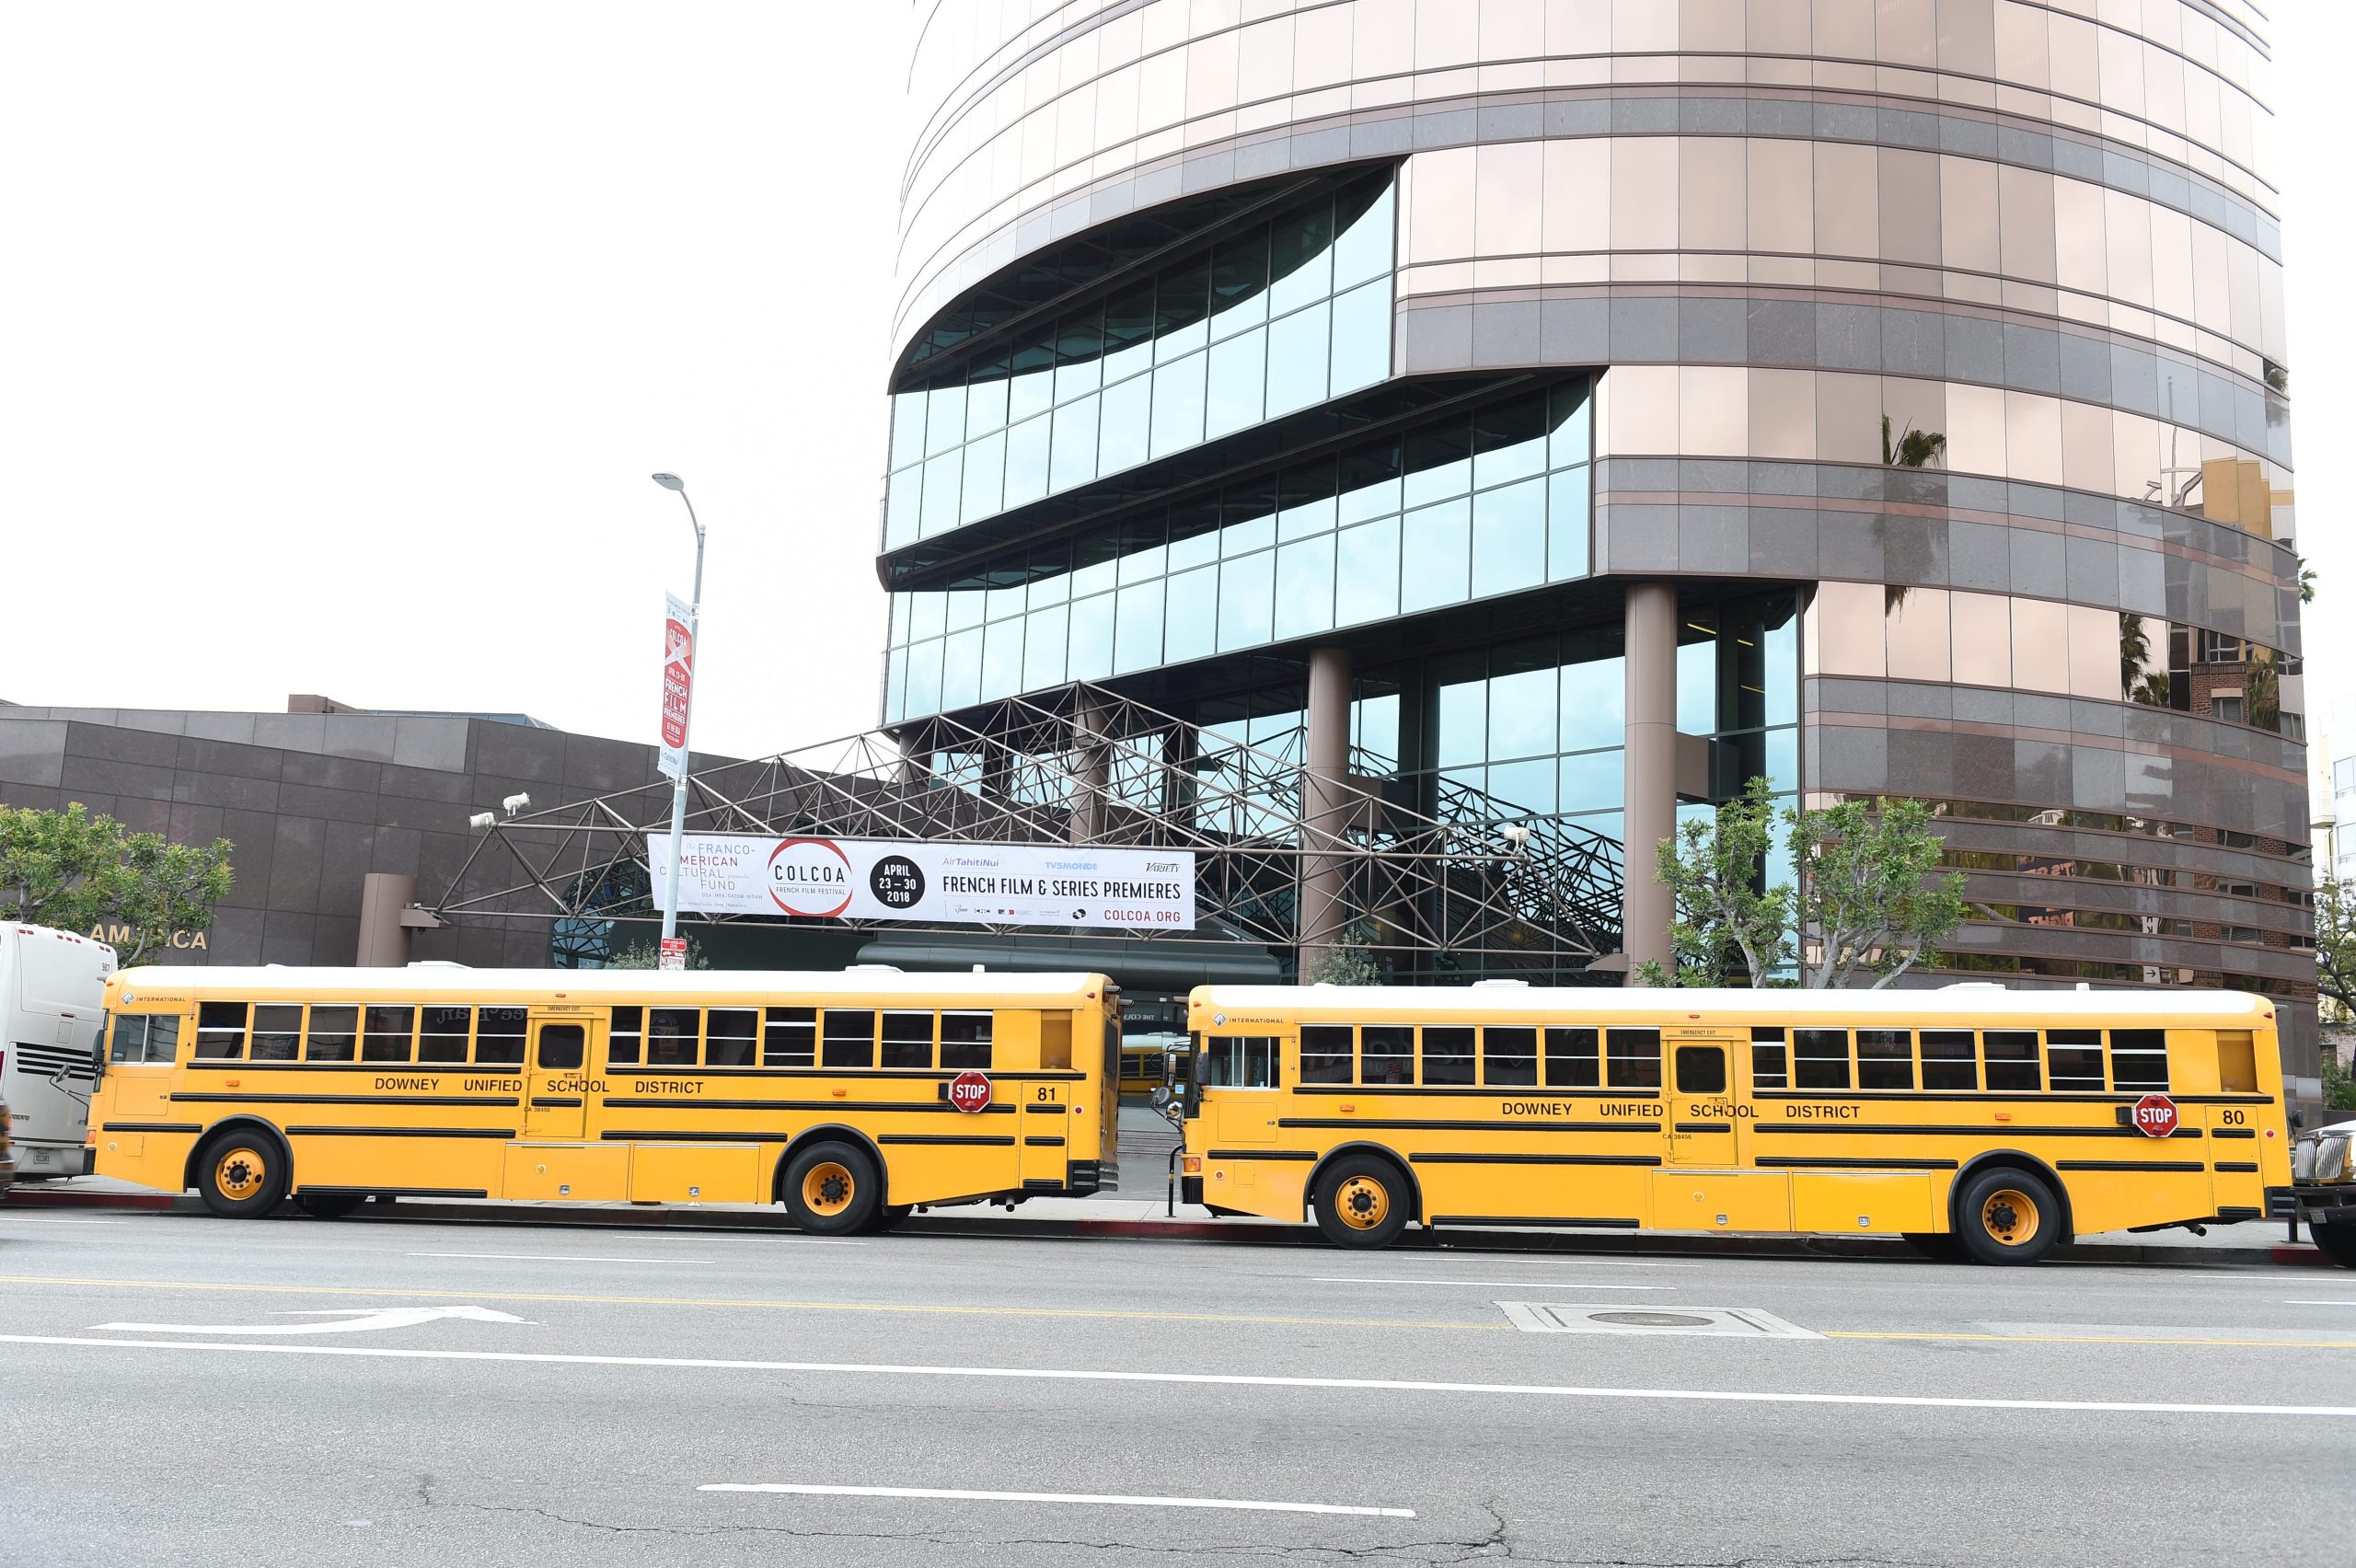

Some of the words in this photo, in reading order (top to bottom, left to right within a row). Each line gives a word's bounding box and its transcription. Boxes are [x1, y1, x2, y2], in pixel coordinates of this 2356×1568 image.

[665, 677, 687, 698] FRENCH
[664, 692, 687, 714] FILM
[698, 843, 756, 855] FRANCO-
[679, 855, 739, 867] MERICAN
[942, 857, 999, 868] AirTahitiNui
[1045, 861, 1098, 870] TV5MONDE
[774, 865, 846, 883] COLCOA
[884, 863, 911, 877] APRIL
[700, 879, 736, 891] FUND
[776, 886, 801, 894] FRENCH
[802, 887, 817, 895] FILM
[817, 888, 847, 896] FESTIVAL
[879, 878, 892, 890] 23
[904, 878, 917, 891] 30
[942, 876, 996, 894] FRENCH
[1001, 878, 1034, 895] FILM
[1038, 880, 1047, 895] &
[1052, 880, 1099, 897] SERIES
[1103, 882, 1182, 900] PREMIERES
[887, 891, 911, 904] 2018
[1104, 909, 1182, 923] COLCOA.ORG
[101, 963, 110, 972] 987
[375, 1078, 440, 1091] DOWNEY
[464, 1078, 523, 1092] UNIFIED
[547, 1080, 610, 1093] SCHOOL
[635, 1080, 704, 1094] DISTRICT
[955, 1084, 987, 1100] STOP
[1037, 1088, 1057, 1102] 81
[1502, 1102, 1573, 1116] DOWNEY
[1600, 1104, 1664, 1117] UNIFIED
[1691, 1105, 1760, 1119] SCHOOL
[1785, 1105, 1861, 1119] DISTRICT
[2140, 1108, 2173, 1124] STOP
[2223, 1110, 2245, 1125] 80
